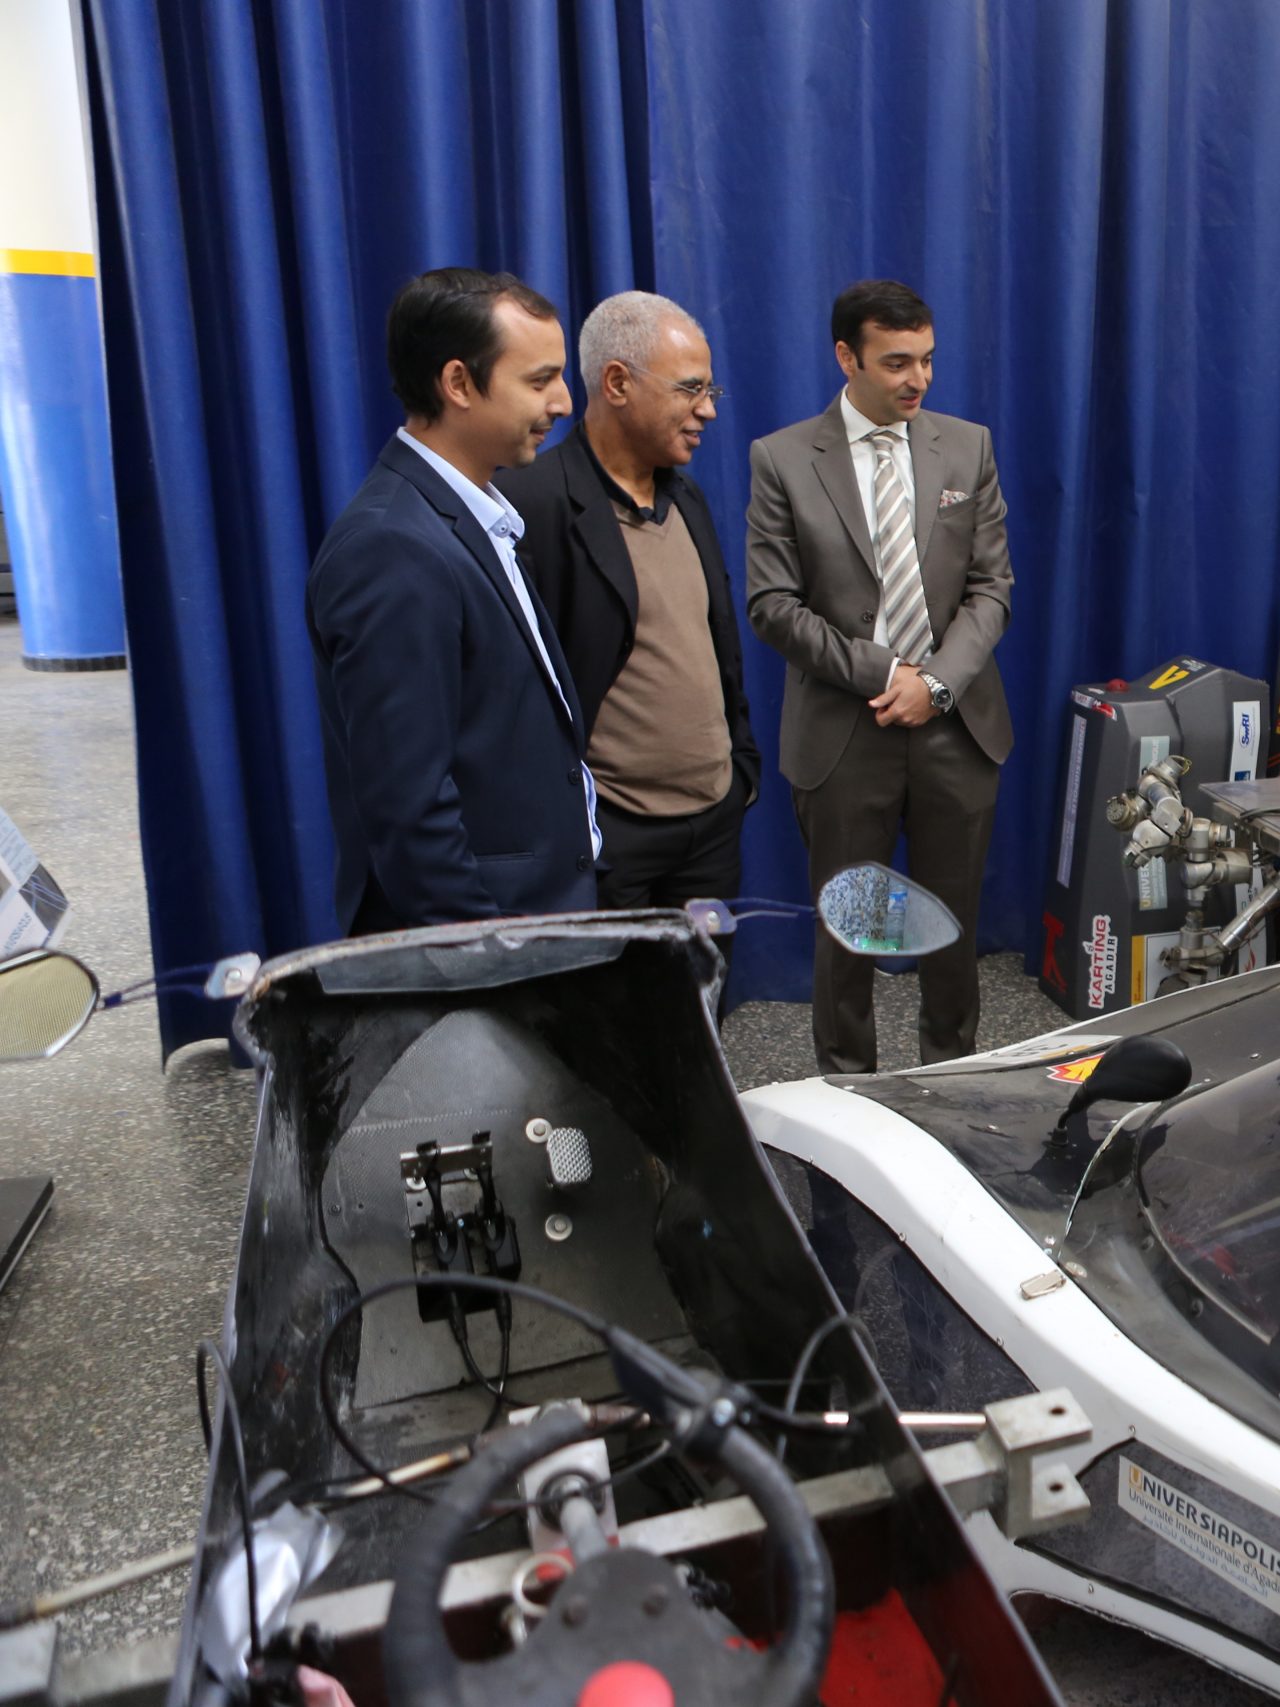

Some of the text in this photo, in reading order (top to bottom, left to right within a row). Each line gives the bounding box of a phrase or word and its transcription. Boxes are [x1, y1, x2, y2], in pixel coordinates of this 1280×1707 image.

[1092, 919, 1107, 1005] KARTING
[1105, 938, 1116, 991] AGADIR
[1176, 1518, 1241, 1567] Internationale
